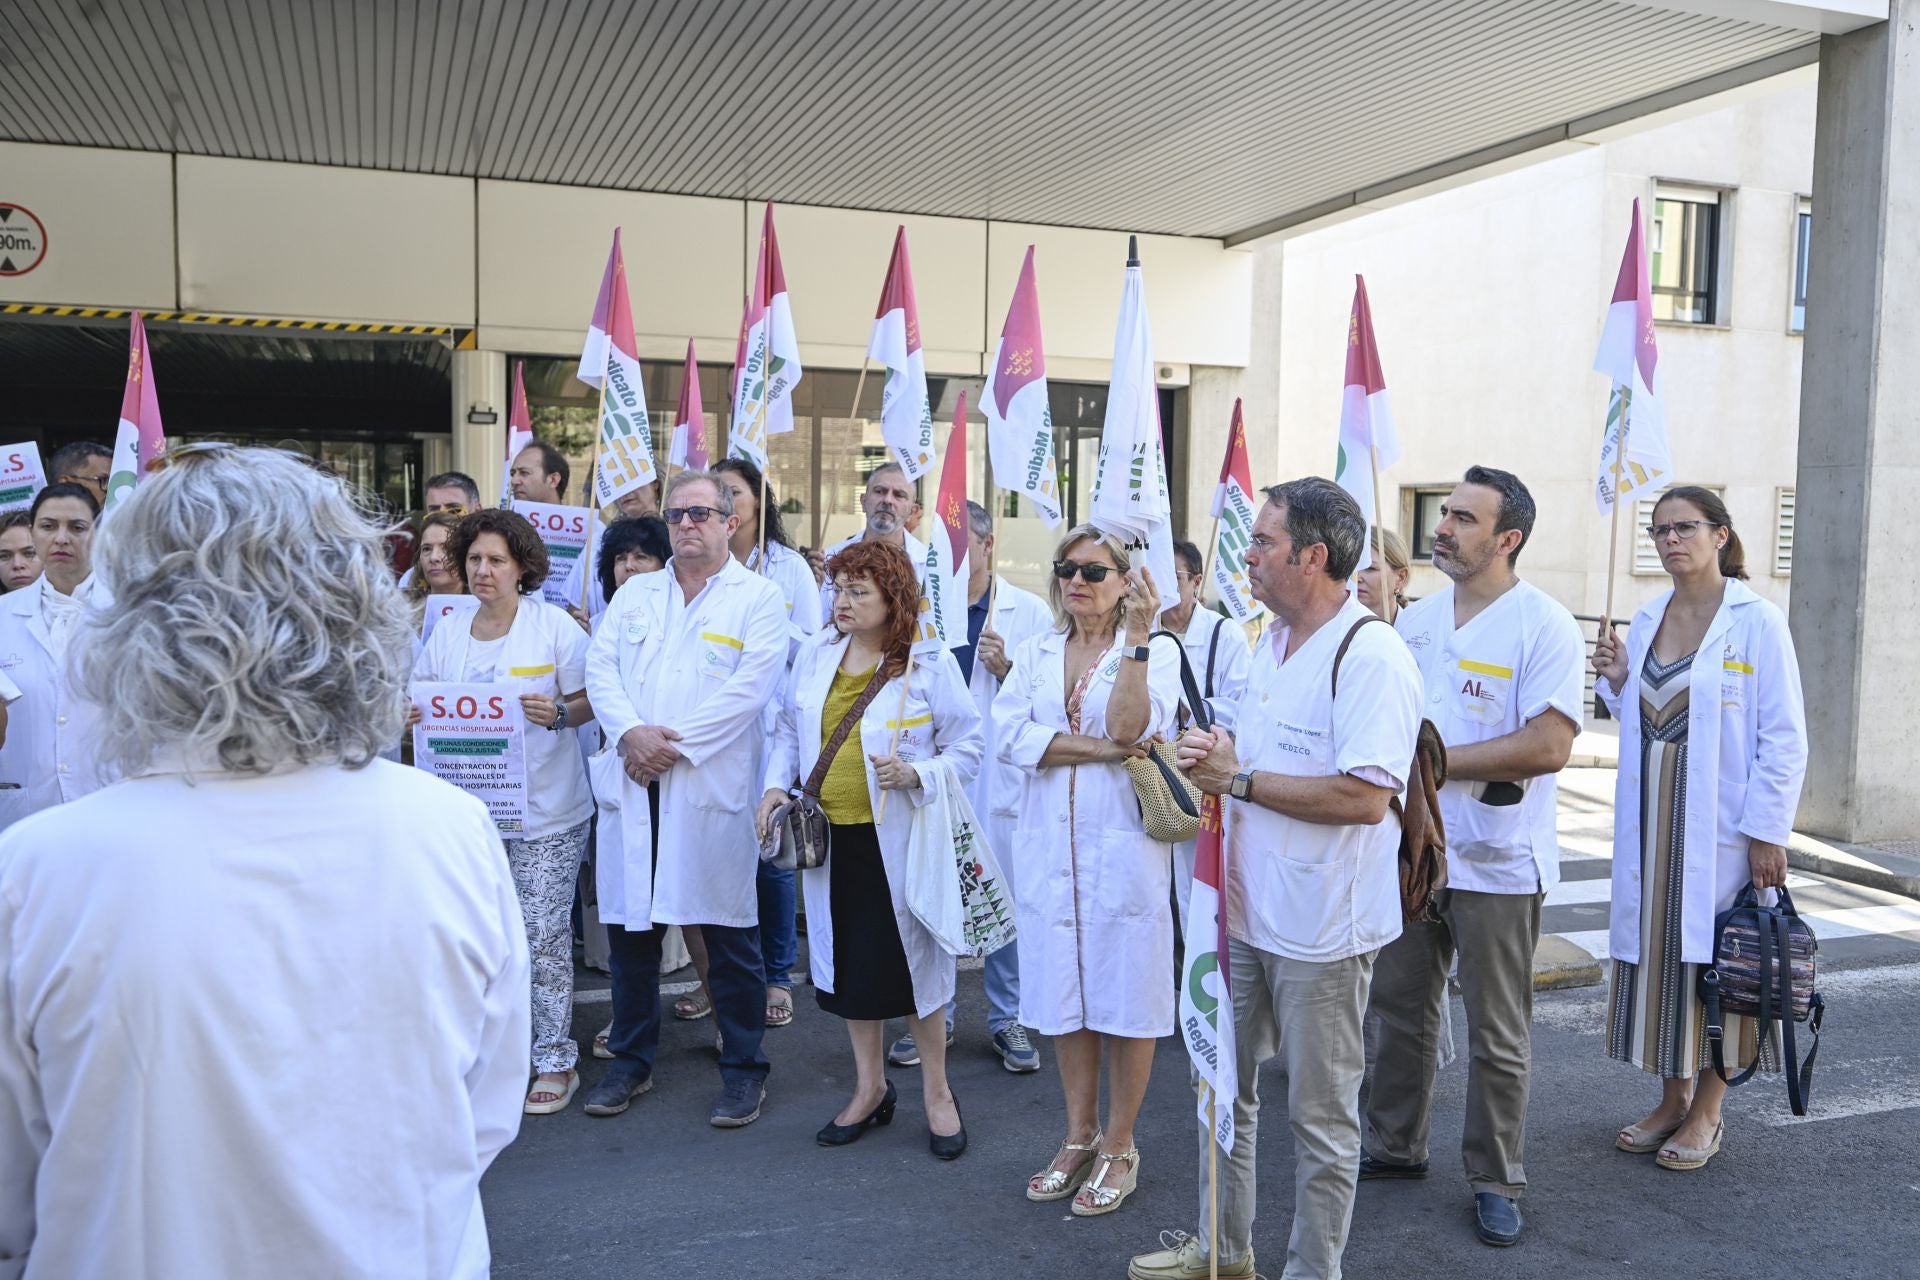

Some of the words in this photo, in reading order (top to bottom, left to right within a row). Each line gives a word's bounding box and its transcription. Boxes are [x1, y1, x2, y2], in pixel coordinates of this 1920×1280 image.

[898, 447, 917, 474] urcia
[529, 511, 584, 533] S.O.S
[1217, 569, 1228, 584] de
[1223, 583, 1247, 618] Murcia
[431, 695, 504, 720] S.O.S
[460, 725, 514, 733] HOSPITALARIAS
[430, 739, 445, 747] POR
[462, 740, 506, 748] CONDICIONES
[1278, 742, 1311, 756] MEDICO
[434, 762, 497, 770] CONCENTRACIÓN
[465, 782, 522, 790] HOSPITALARIAS
